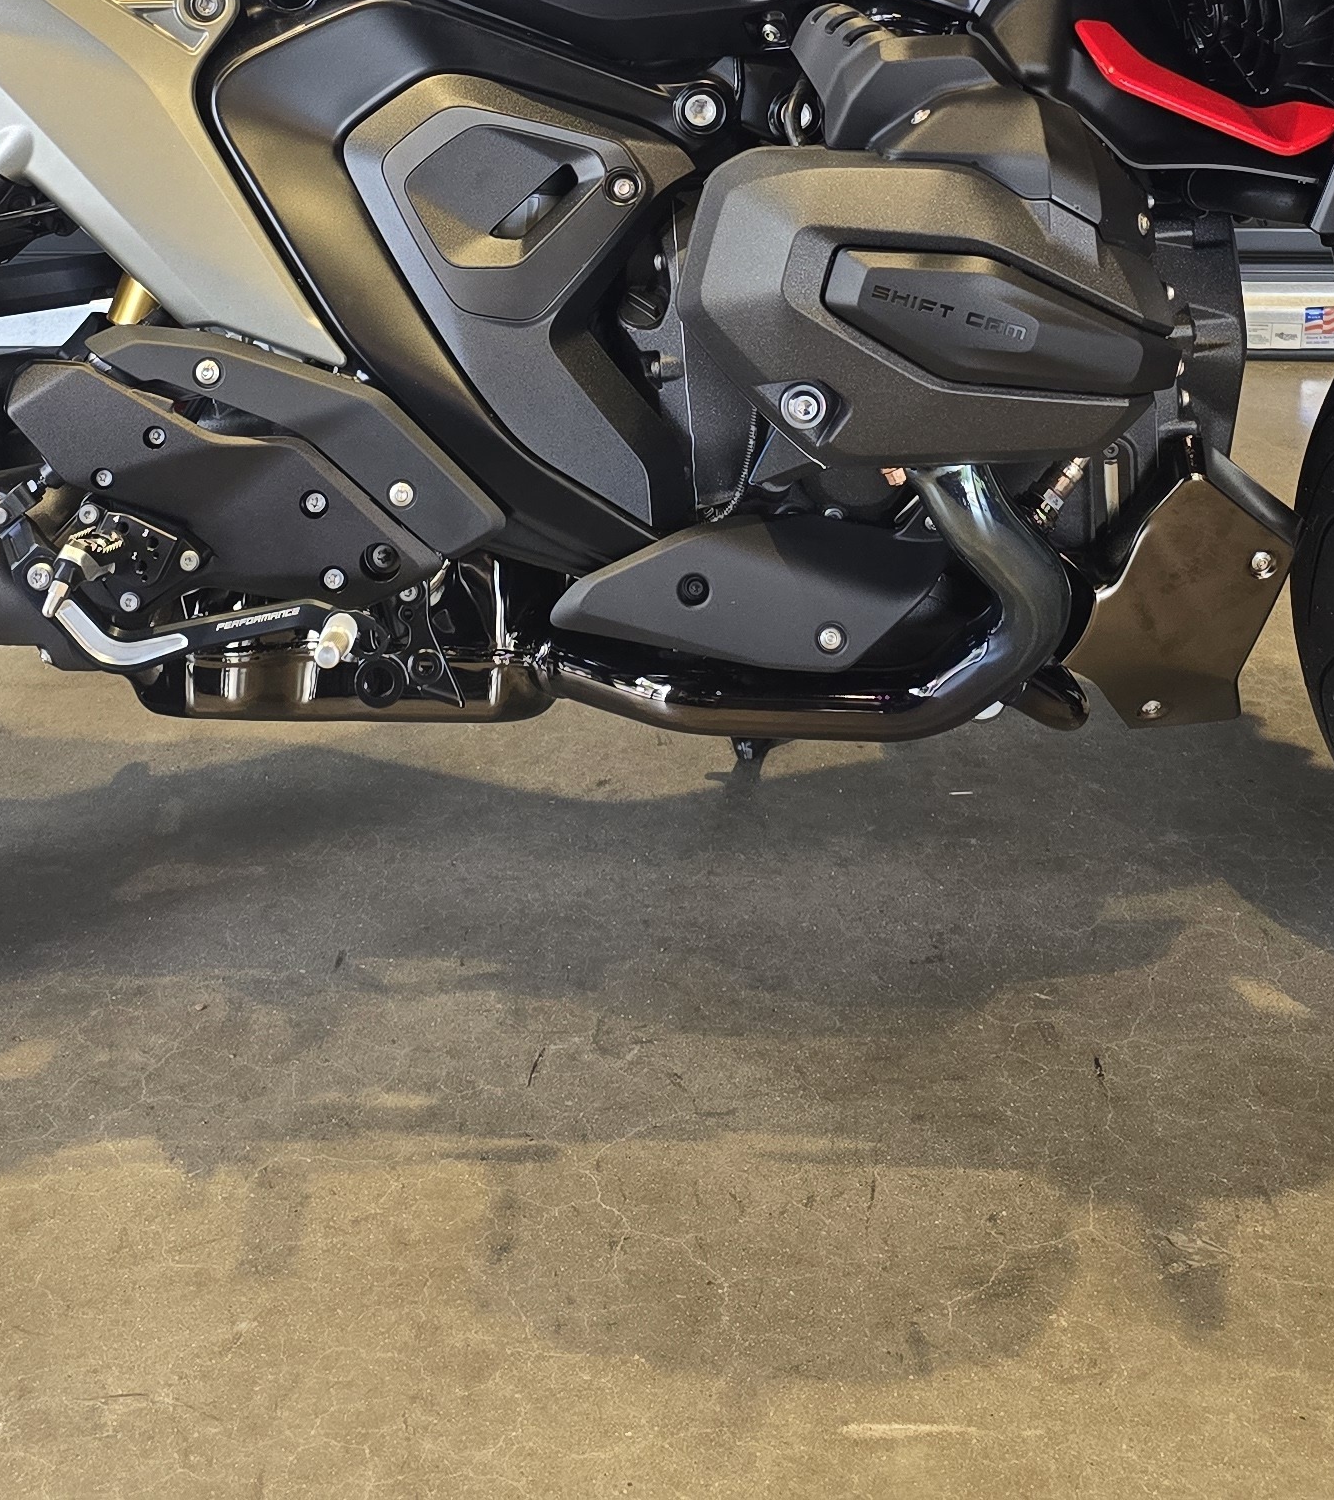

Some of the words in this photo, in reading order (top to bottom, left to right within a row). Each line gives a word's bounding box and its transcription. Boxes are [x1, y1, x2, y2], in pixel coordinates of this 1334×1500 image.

[870, 284, 956, 318] SHIFT
[965, 311, 1029, 341] CAM
[215, 606, 301, 632] PERFORMANCE
